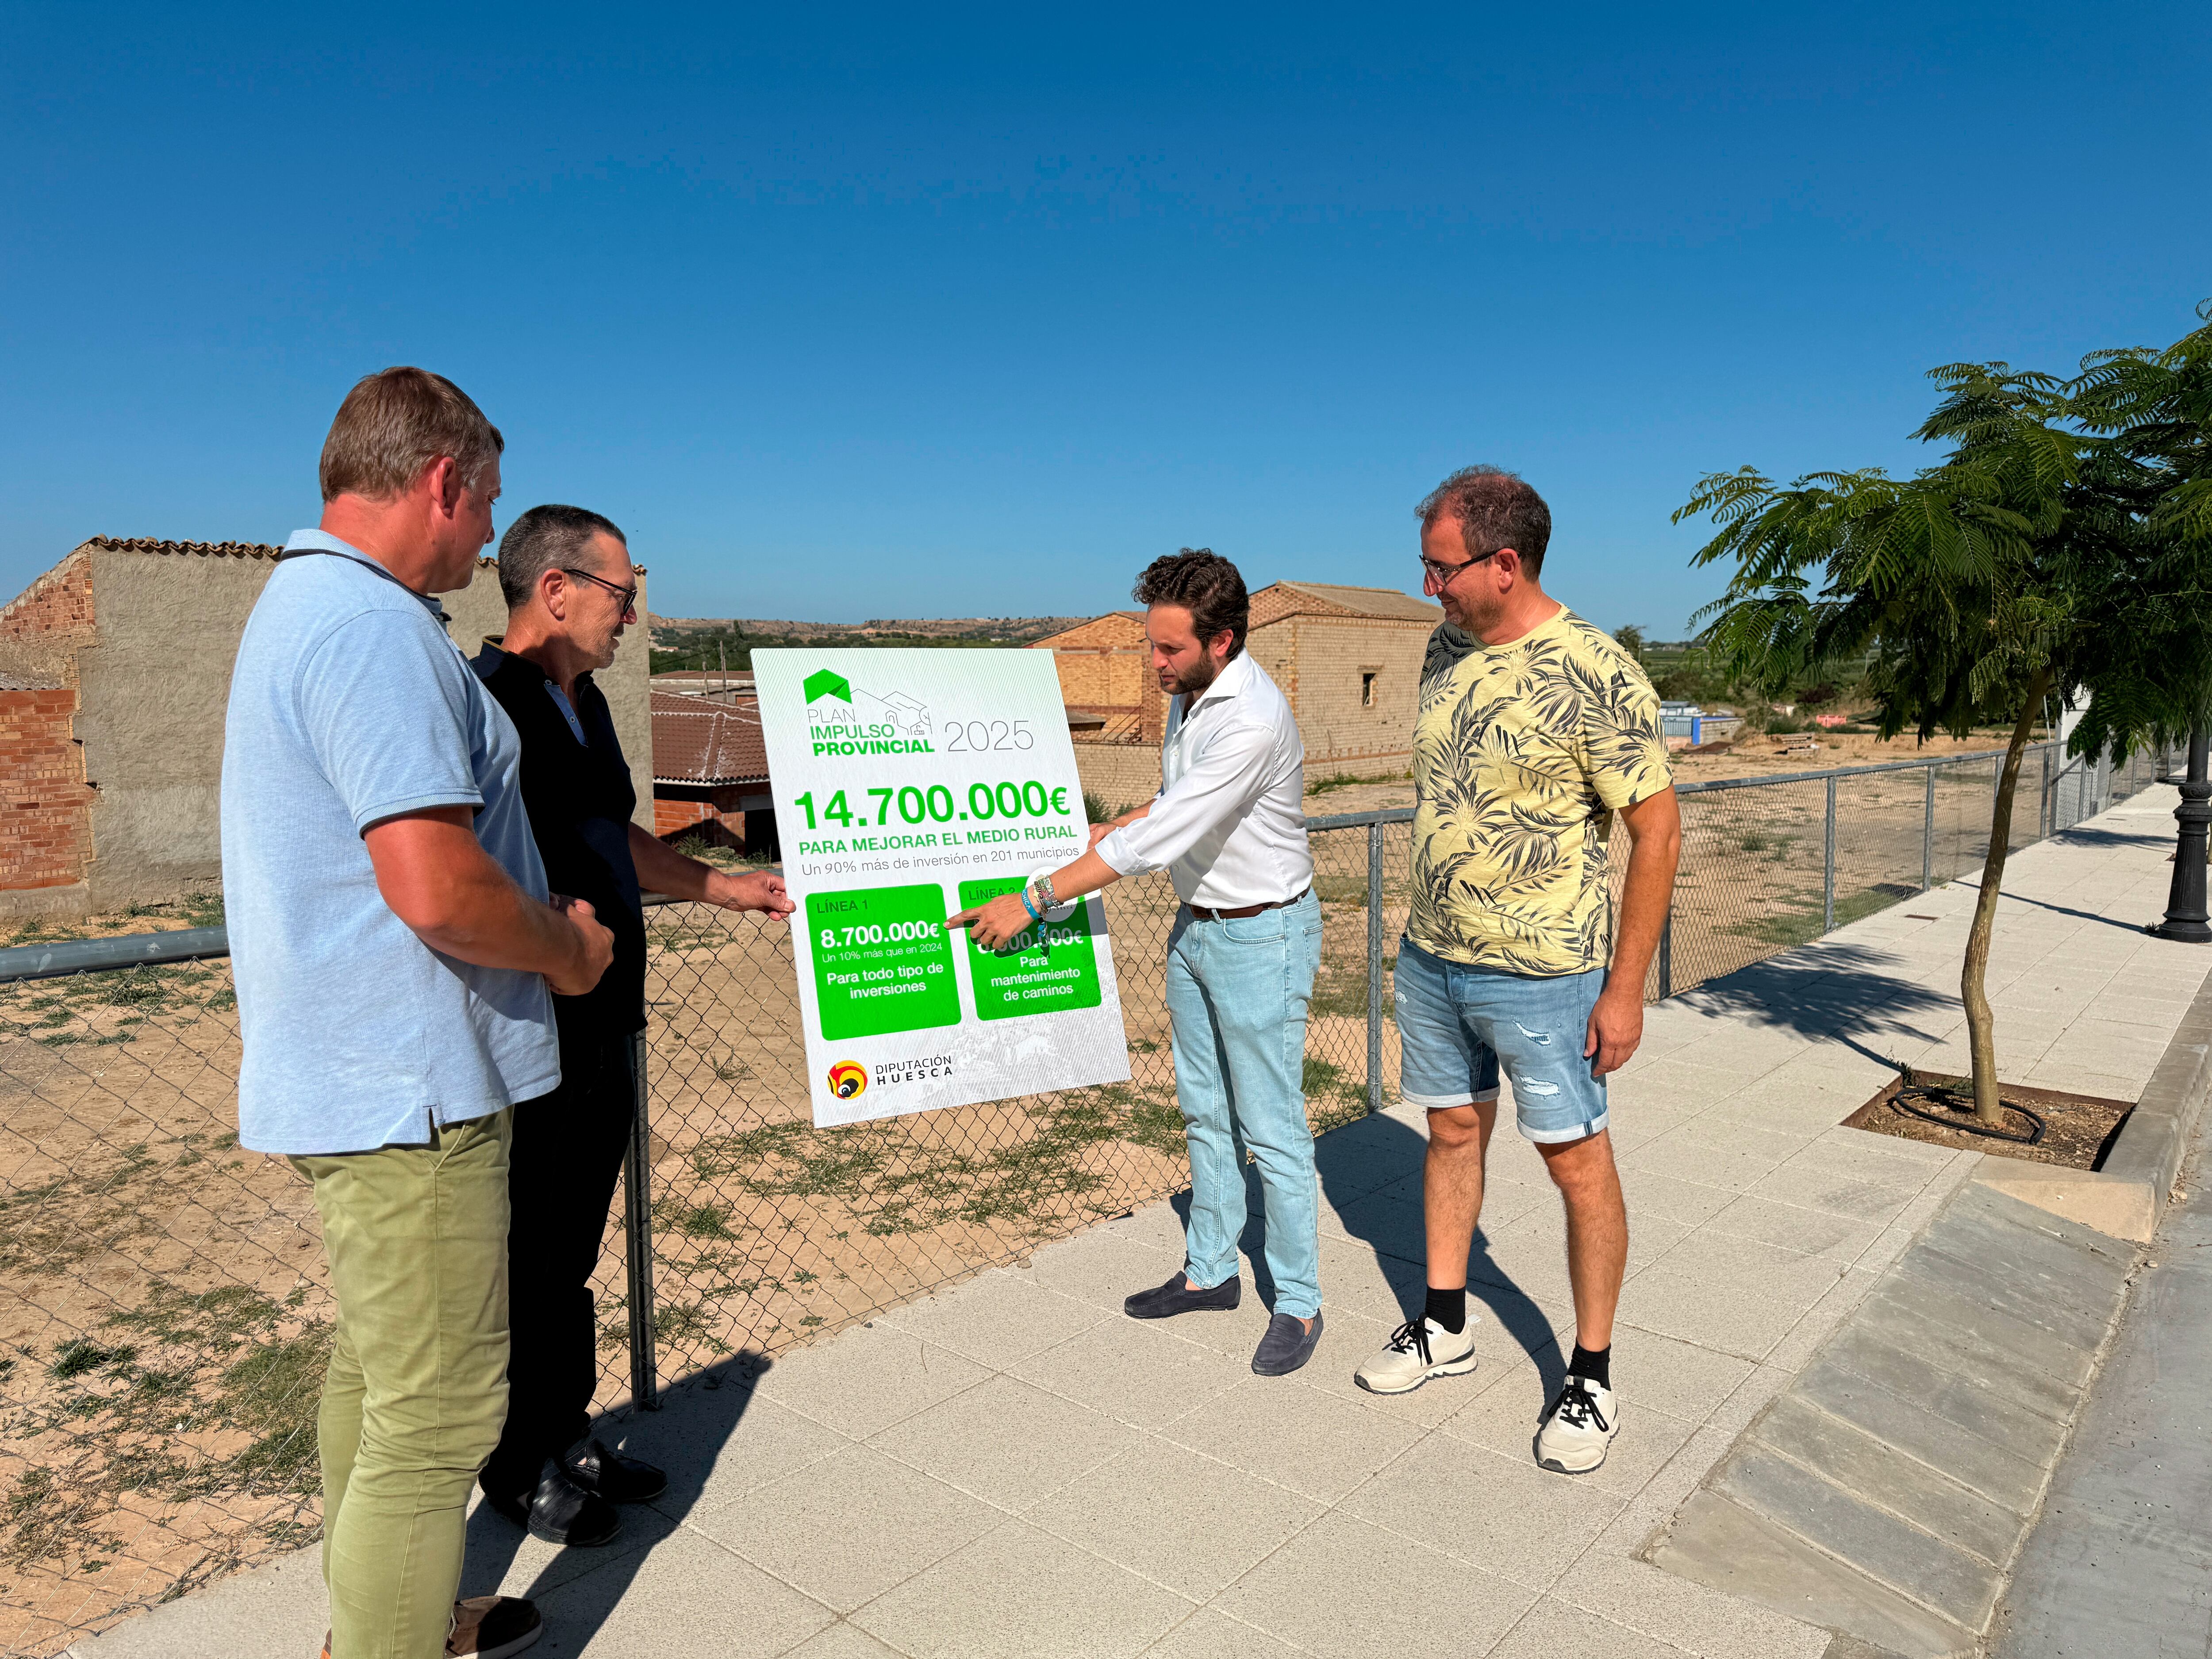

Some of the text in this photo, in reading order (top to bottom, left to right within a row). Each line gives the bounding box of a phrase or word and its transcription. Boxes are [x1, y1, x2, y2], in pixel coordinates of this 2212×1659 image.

[808, 709, 855, 723] PLAN
[810, 724, 895, 739] IMPULSO
[945, 721, 1033, 752] 2025
[813, 739, 935, 757] PROVINCIAL
[794, 780, 1071, 830] 14.700.000€
[799, 825, 1078, 855] PARA MEJORAR EL MEDIO RURAL
[802, 846, 1079, 876] Un 90% más de inversión en 201 municipios
[968, 886, 1005, 900] LÍNEA
[816, 899, 868, 914] LÍNEA 1
[821, 920, 940, 948] 8.700.000€
[822, 942, 943, 963] Un 10% más que en 2024
[1020, 956, 1049, 968] Para
[827, 962, 944, 985] Para todo tipo de
[991, 967, 1081, 987] mantenimiento
[849, 982, 927, 999] inversiones
[1003, 984, 1074, 1001] de caminos
[876, 1054, 952, 1074] DIPUTACIÓN
[877, 1067, 952, 1085] HUESCA
